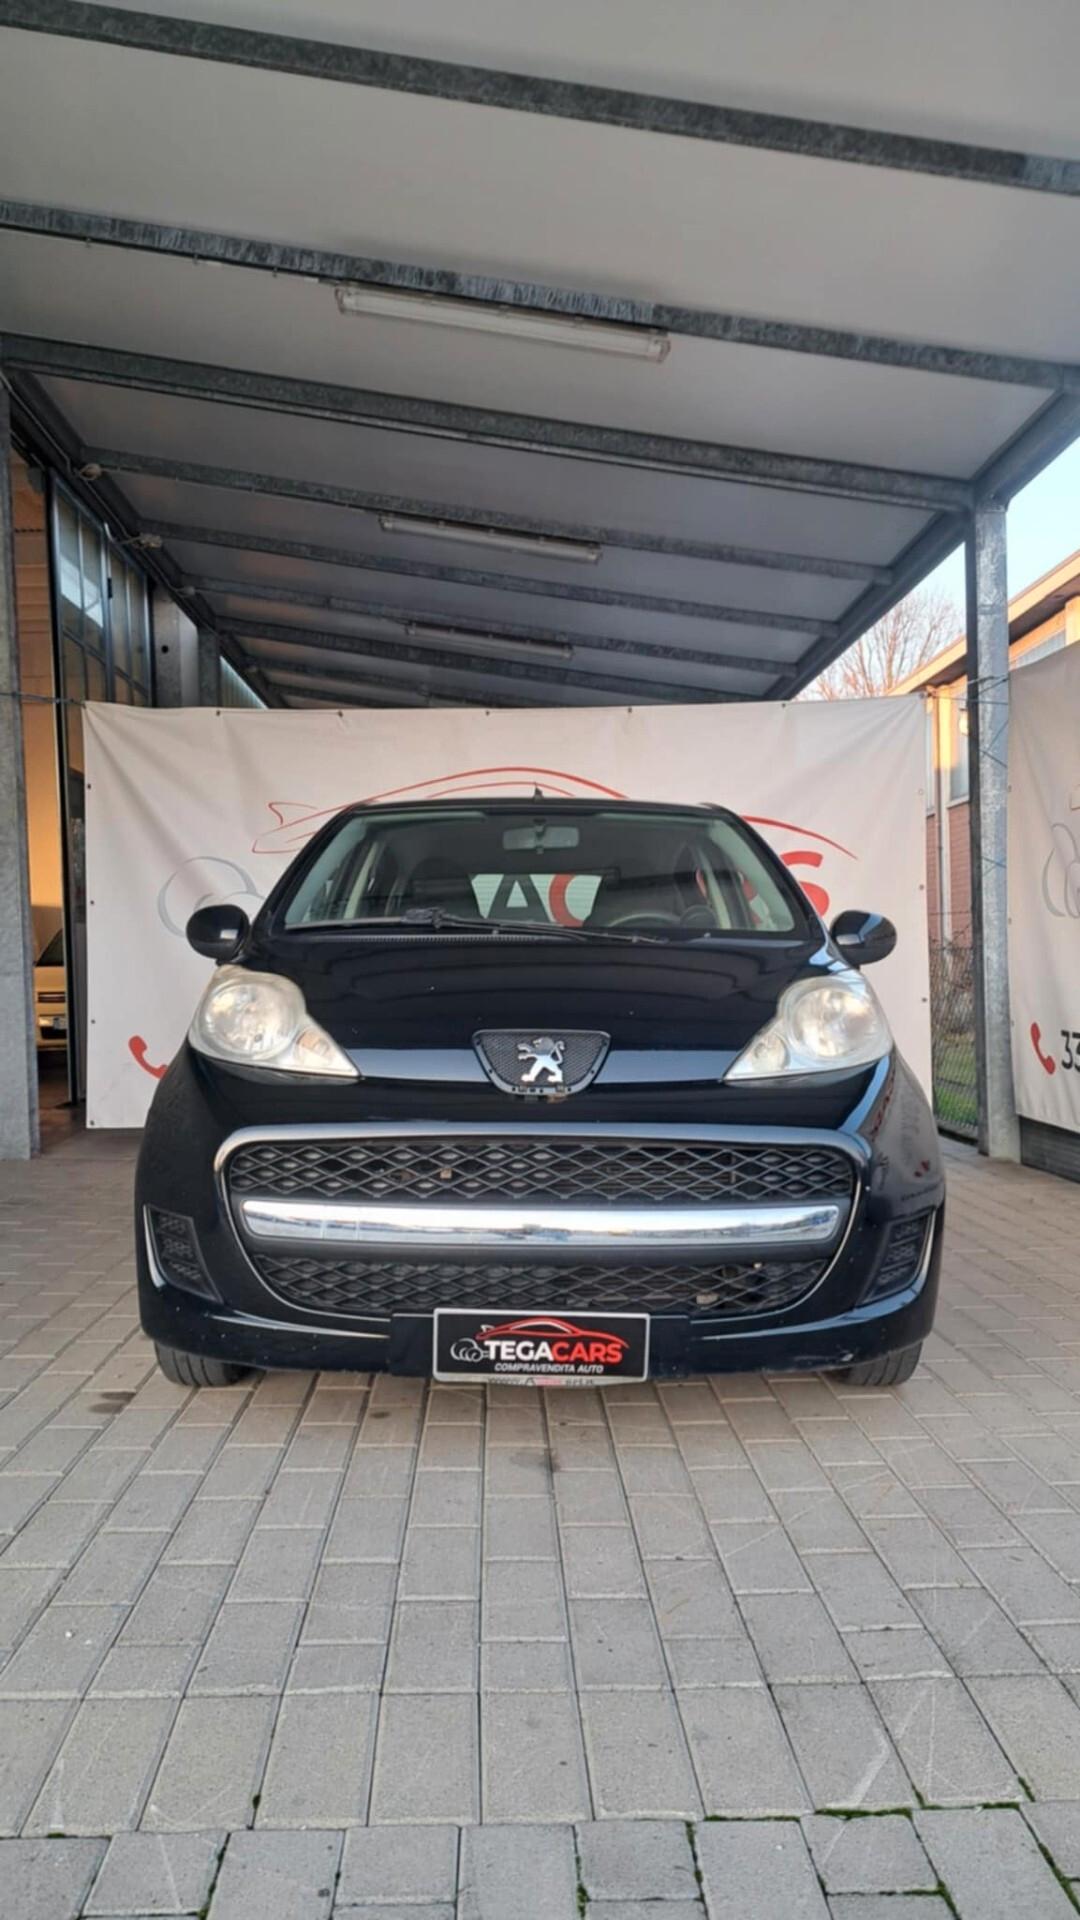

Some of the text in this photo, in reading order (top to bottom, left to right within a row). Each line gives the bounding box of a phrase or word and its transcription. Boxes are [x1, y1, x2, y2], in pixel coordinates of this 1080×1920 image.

[484, 1340, 623, 1363] TEGACARS
[494, 1362, 604, 1374] COMPRAVENDITA AUTO
